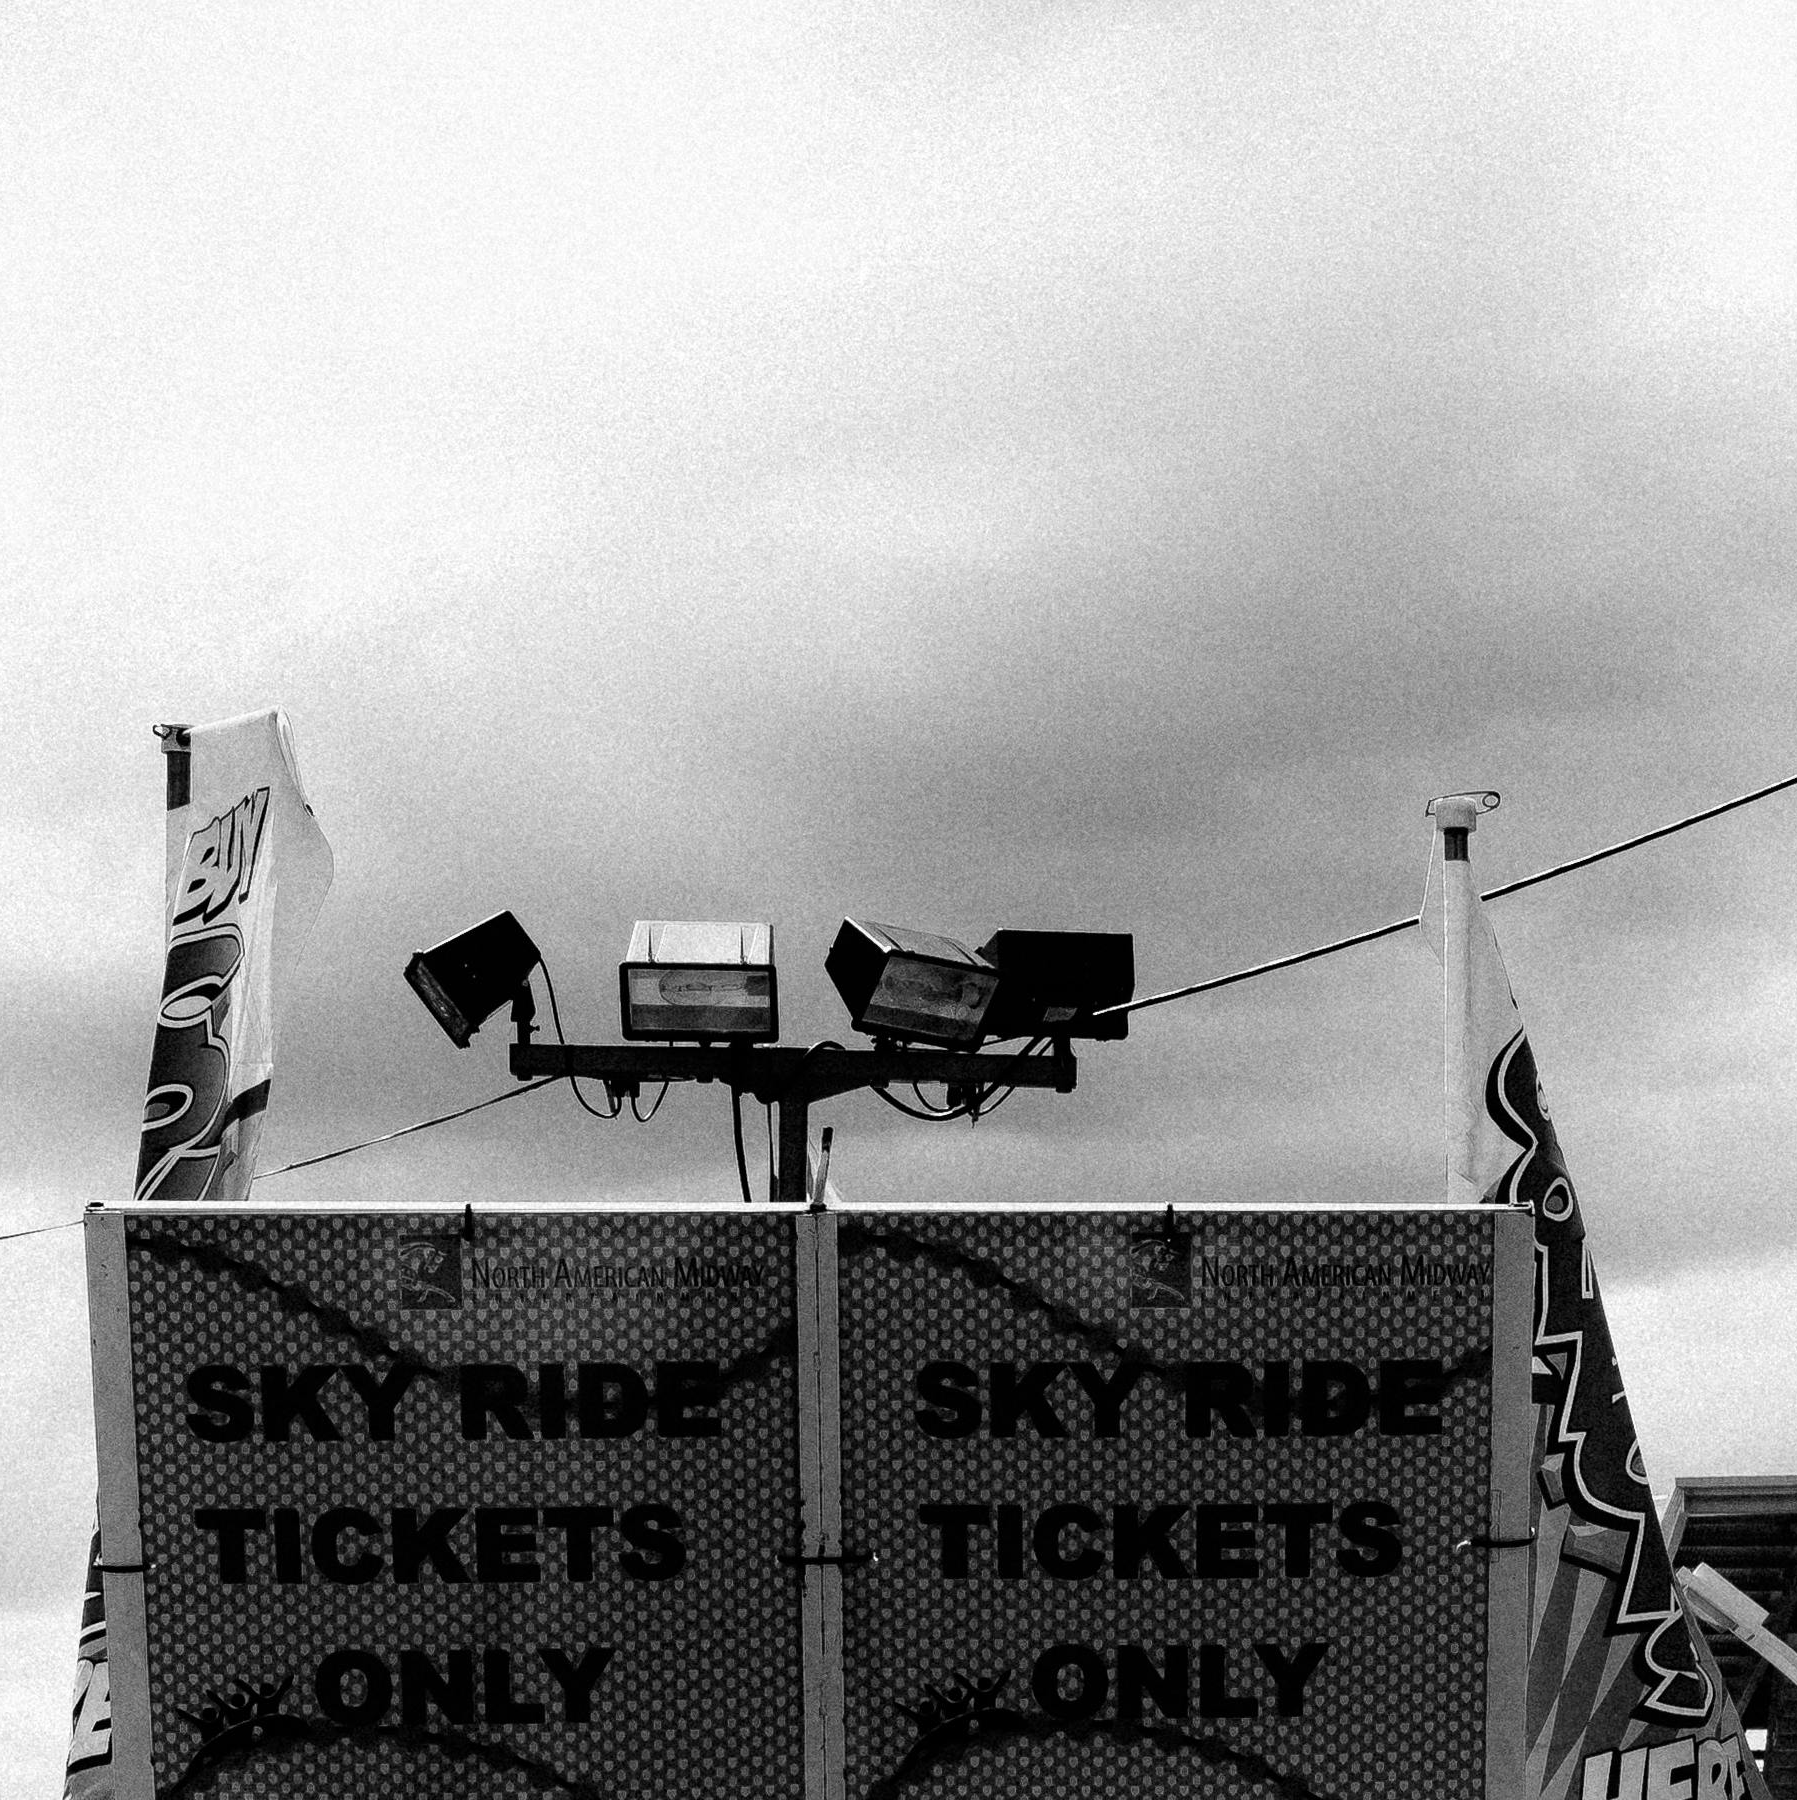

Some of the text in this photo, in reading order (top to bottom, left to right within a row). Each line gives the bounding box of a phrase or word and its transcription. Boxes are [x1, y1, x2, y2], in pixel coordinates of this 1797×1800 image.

[186, 1362, 721, 1442] SKY RIDE
[915, 1360, 1442, 1439] SKY RIDE
[195, 1505, 686, 1584] TICKETS
[920, 1502, 1402, 1580] TICKETS
[315, 1648, 615, 1727] ONLY
[1032, 1643, 1329, 1720] ONLY
